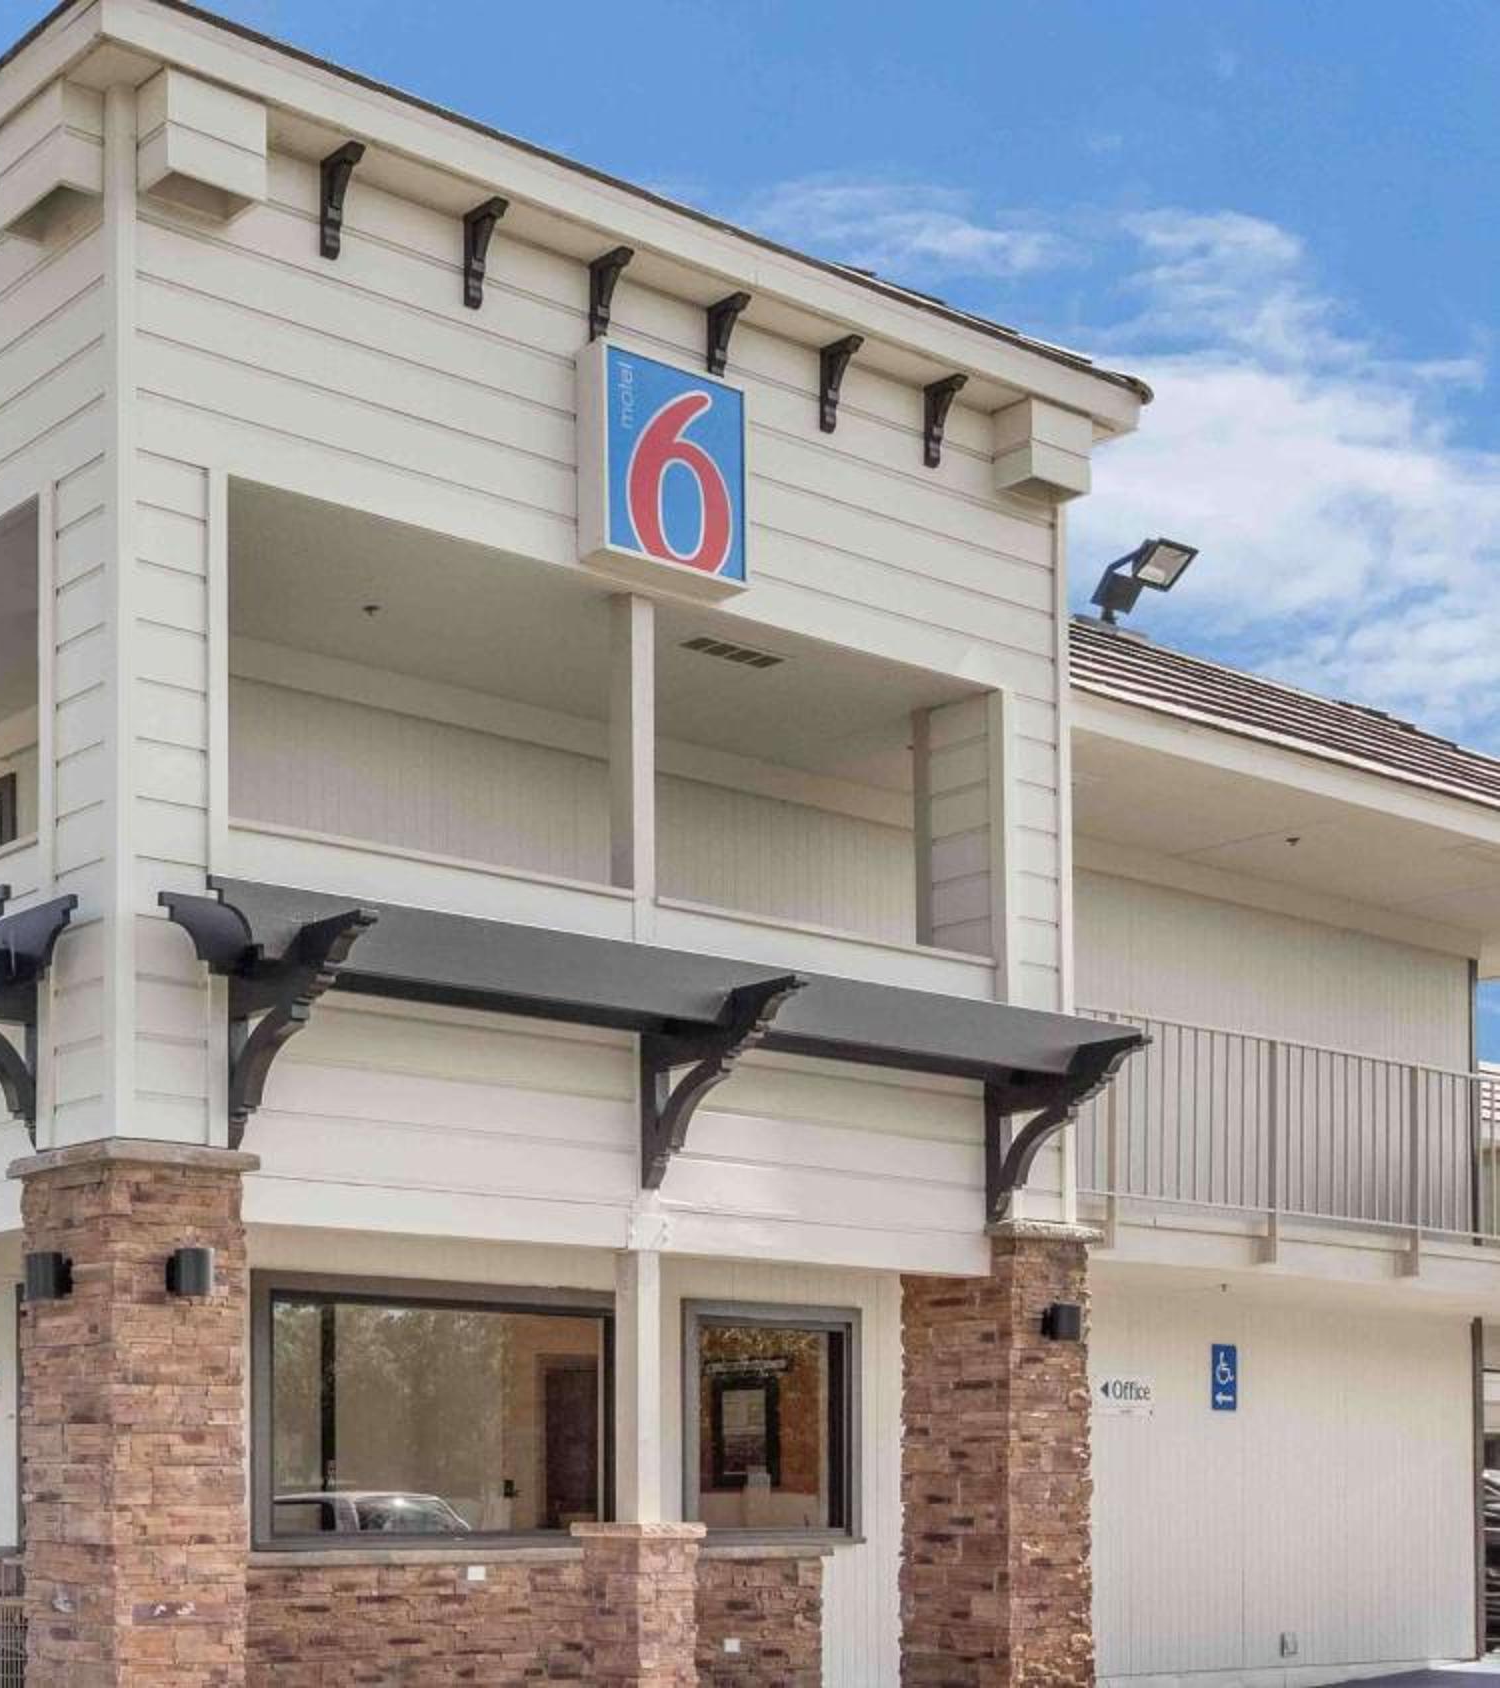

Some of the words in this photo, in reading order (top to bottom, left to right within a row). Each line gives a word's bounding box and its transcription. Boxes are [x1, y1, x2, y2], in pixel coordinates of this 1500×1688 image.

[617, 361, 634, 429] motel
[626, 390, 733, 575] 6
[1112, 1380, 1150, 1401] Office
